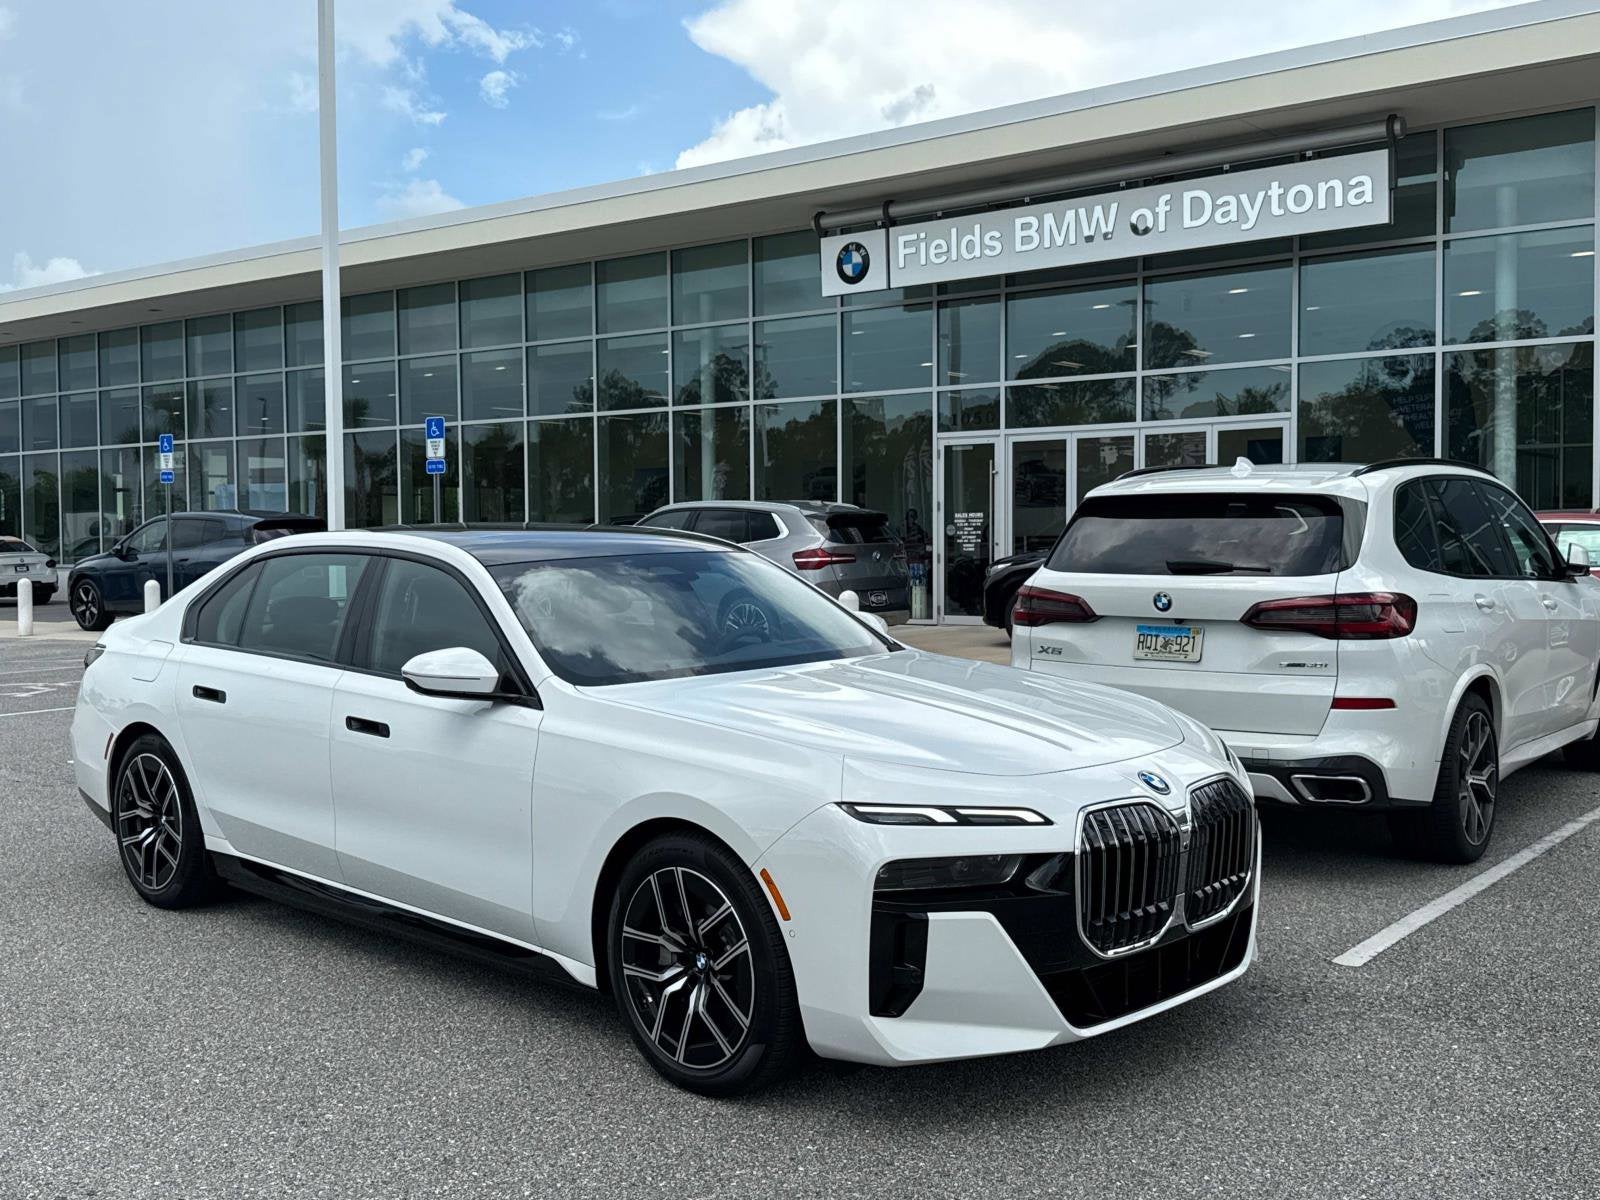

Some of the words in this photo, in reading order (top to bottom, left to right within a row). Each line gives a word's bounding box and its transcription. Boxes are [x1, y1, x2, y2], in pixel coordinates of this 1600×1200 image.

[898, 223, 1003, 269] Fields
[1014, 202, 1119, 253] BMW
[1129, 194, 1171, 236] of
[1183, 174, 1373, 231] Daytona
[1174, 635, 1196, 653] 921
